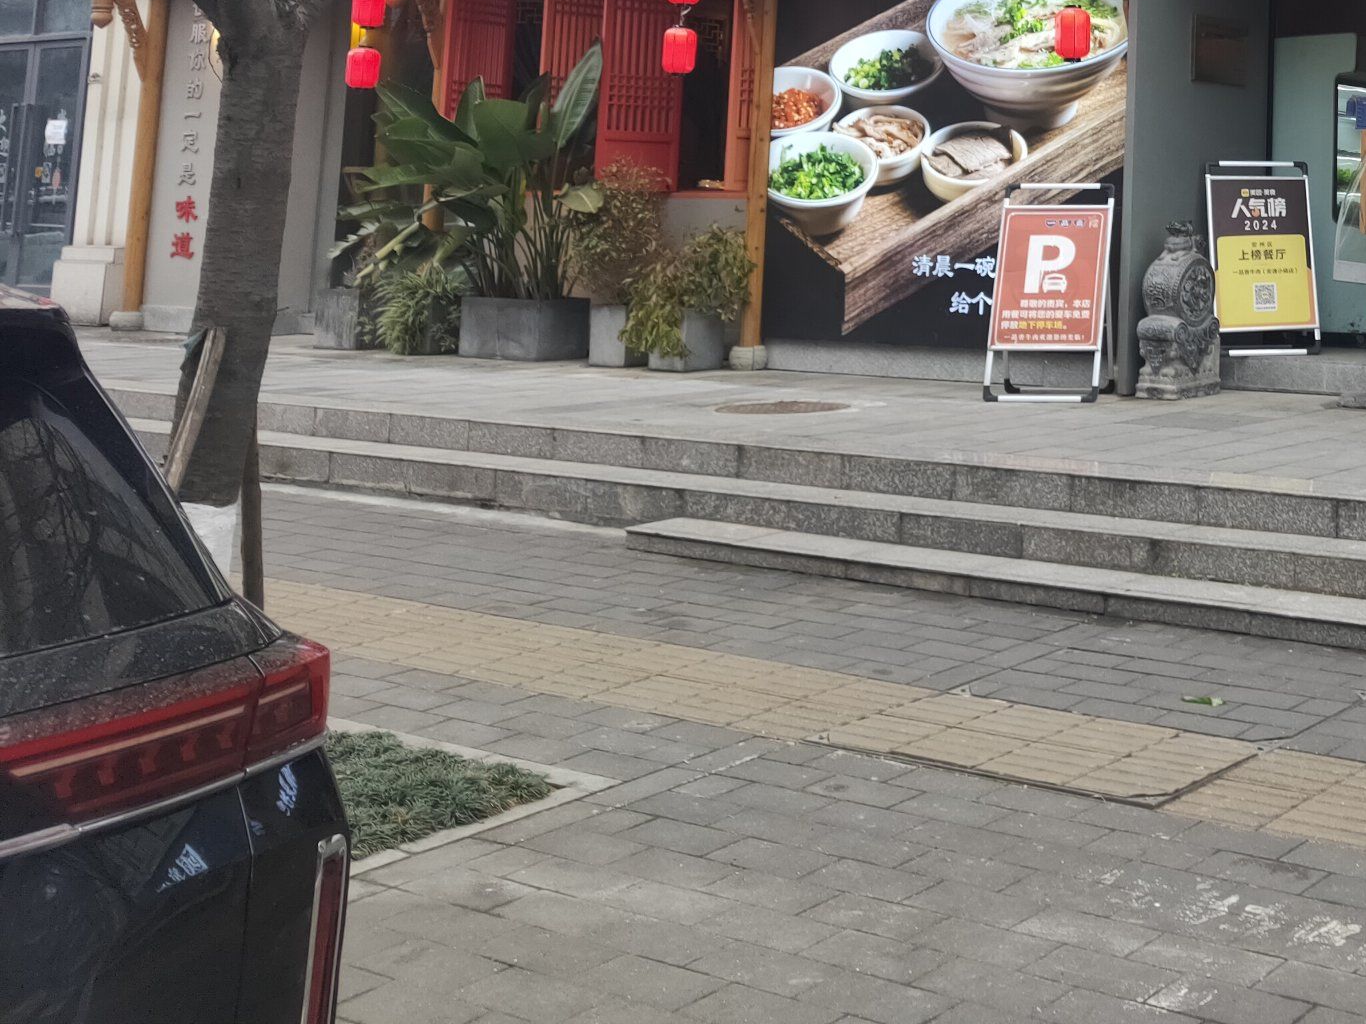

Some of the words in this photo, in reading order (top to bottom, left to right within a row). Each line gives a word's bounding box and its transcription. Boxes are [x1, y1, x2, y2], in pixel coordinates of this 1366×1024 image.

[170, 4, 208, 260] 服你的一定是味道
[1231, 198, 1286, 218] 人气榜
[1244, 220, 1277, 231] 2024
[1024, 235, 1076, 293] P
[1238, 249, 1286, 261] 上榜餐厅
[912, 255, 996, 279] 清晨一碗
[949, 292, 993, 315] 给个
